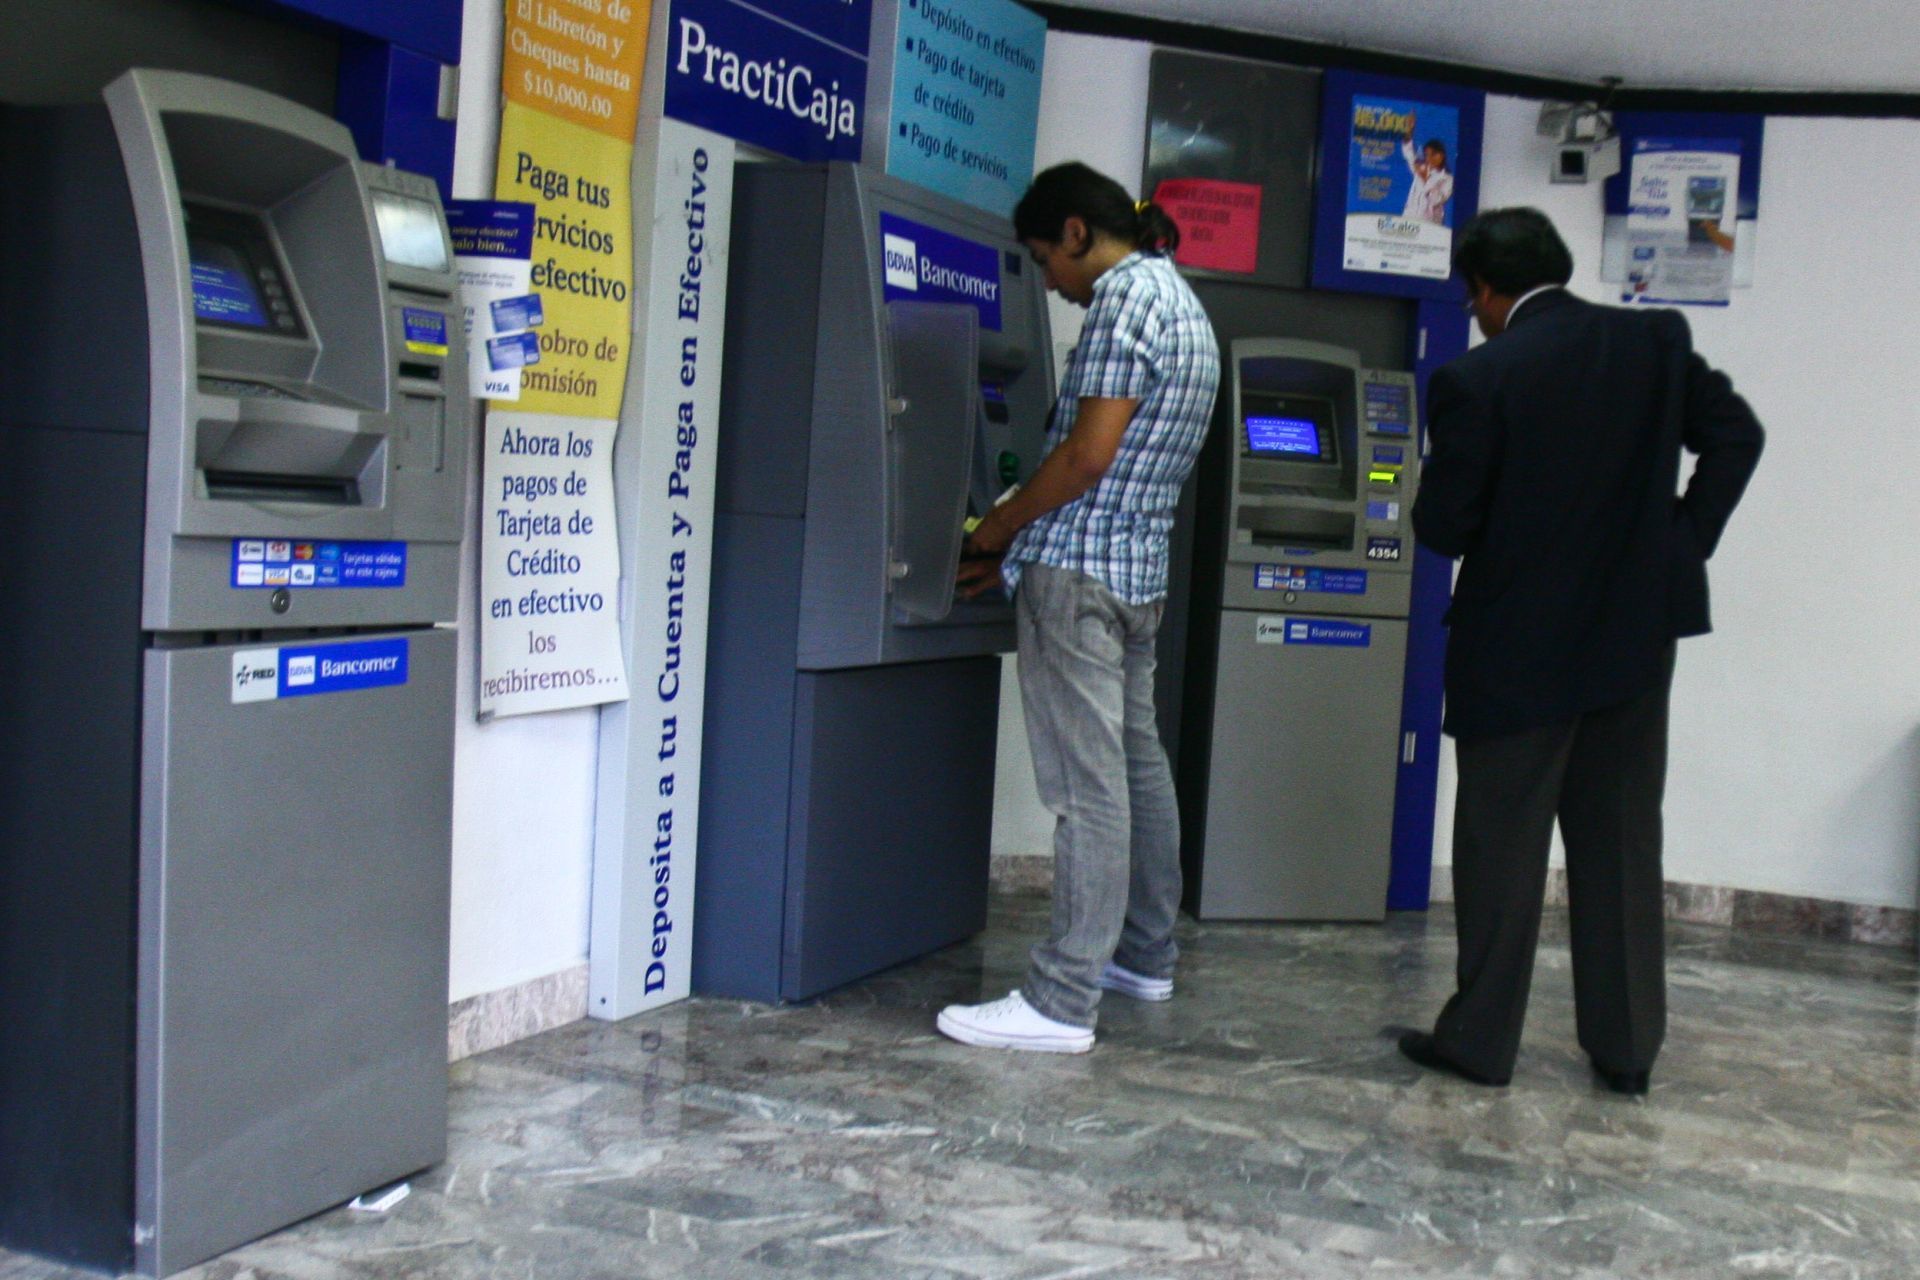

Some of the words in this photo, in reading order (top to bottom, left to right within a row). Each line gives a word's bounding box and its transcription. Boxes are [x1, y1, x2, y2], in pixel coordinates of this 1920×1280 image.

[536, 2, 608, 51] Libretón
[611, 37, 624, 59] y
[607, 0, 631, 24] de
[921, 0, 974, 42] Depósito
[977, 31, 991, 51] en
[994, 36, 1036, 74] efectivo
[511, 27, 580, 74] Cheques
[584, 55, 631, 91] hasta
[676, 17, 857, 141] PractiCaja
[918, 37, 947, 74] Pago
[951, 52, 965, 81] de
[969, 64, 1006, 99] tarjeta
[524, 69, 612, 119] $10,000.00
[914, 81, 930, 106] de
[933, 93, 975, 126] crédito
[912, 122, 940, 158] Pago
[944, 137, 958, 160] de
[962, 148, 1009, 181] servicios
[515, 151, 569, 201] Paga
[576, 176, 611, 209] tus
[535, 213, 614, 255] rvicios
[678, 148, 709, 324] Efectivo
[530, 257, 627, 302] efectivo
[886, 250, 915, 276] BBVA
[920, 255, 998, 301] Bancomer
[539, 328, 589, 358] obro
[594, 336, 618, 362] de
[680, 336, 698, 389] en
[485, 382, 510, 392] VISA
[520, 367, 598, 398] omisión
[500, 427, 560, 457] Ahora
[566, 431, 593, 458] los
[668, 401, 698, 500] Paga
[502, 473, 557, 502] pagos
[563, 470, 587, 496] de
[497, 509, 561, 542] Tarjeta
[568, 509, 593, 535] de
[672, 512, 692, 538] y
[506, 549, 581, 577] Crédito
[491, 596, 513, 618] en
[518, 587, 604, 617] efectivo
[528, 630, 556, 655] los
[658, 550, 686, 703] Cuenta
[1311, 627, 1364, 640] Bancomer
[252, 668, 275, 680] RED
[321, 656, 399, 678] Bancomer
[483, 666, 619, 697] recibiremos...
[658, 715, 677, 763] tu
[659, 772, 675, 797] a
[644, 808, 673, 997] Deposita
